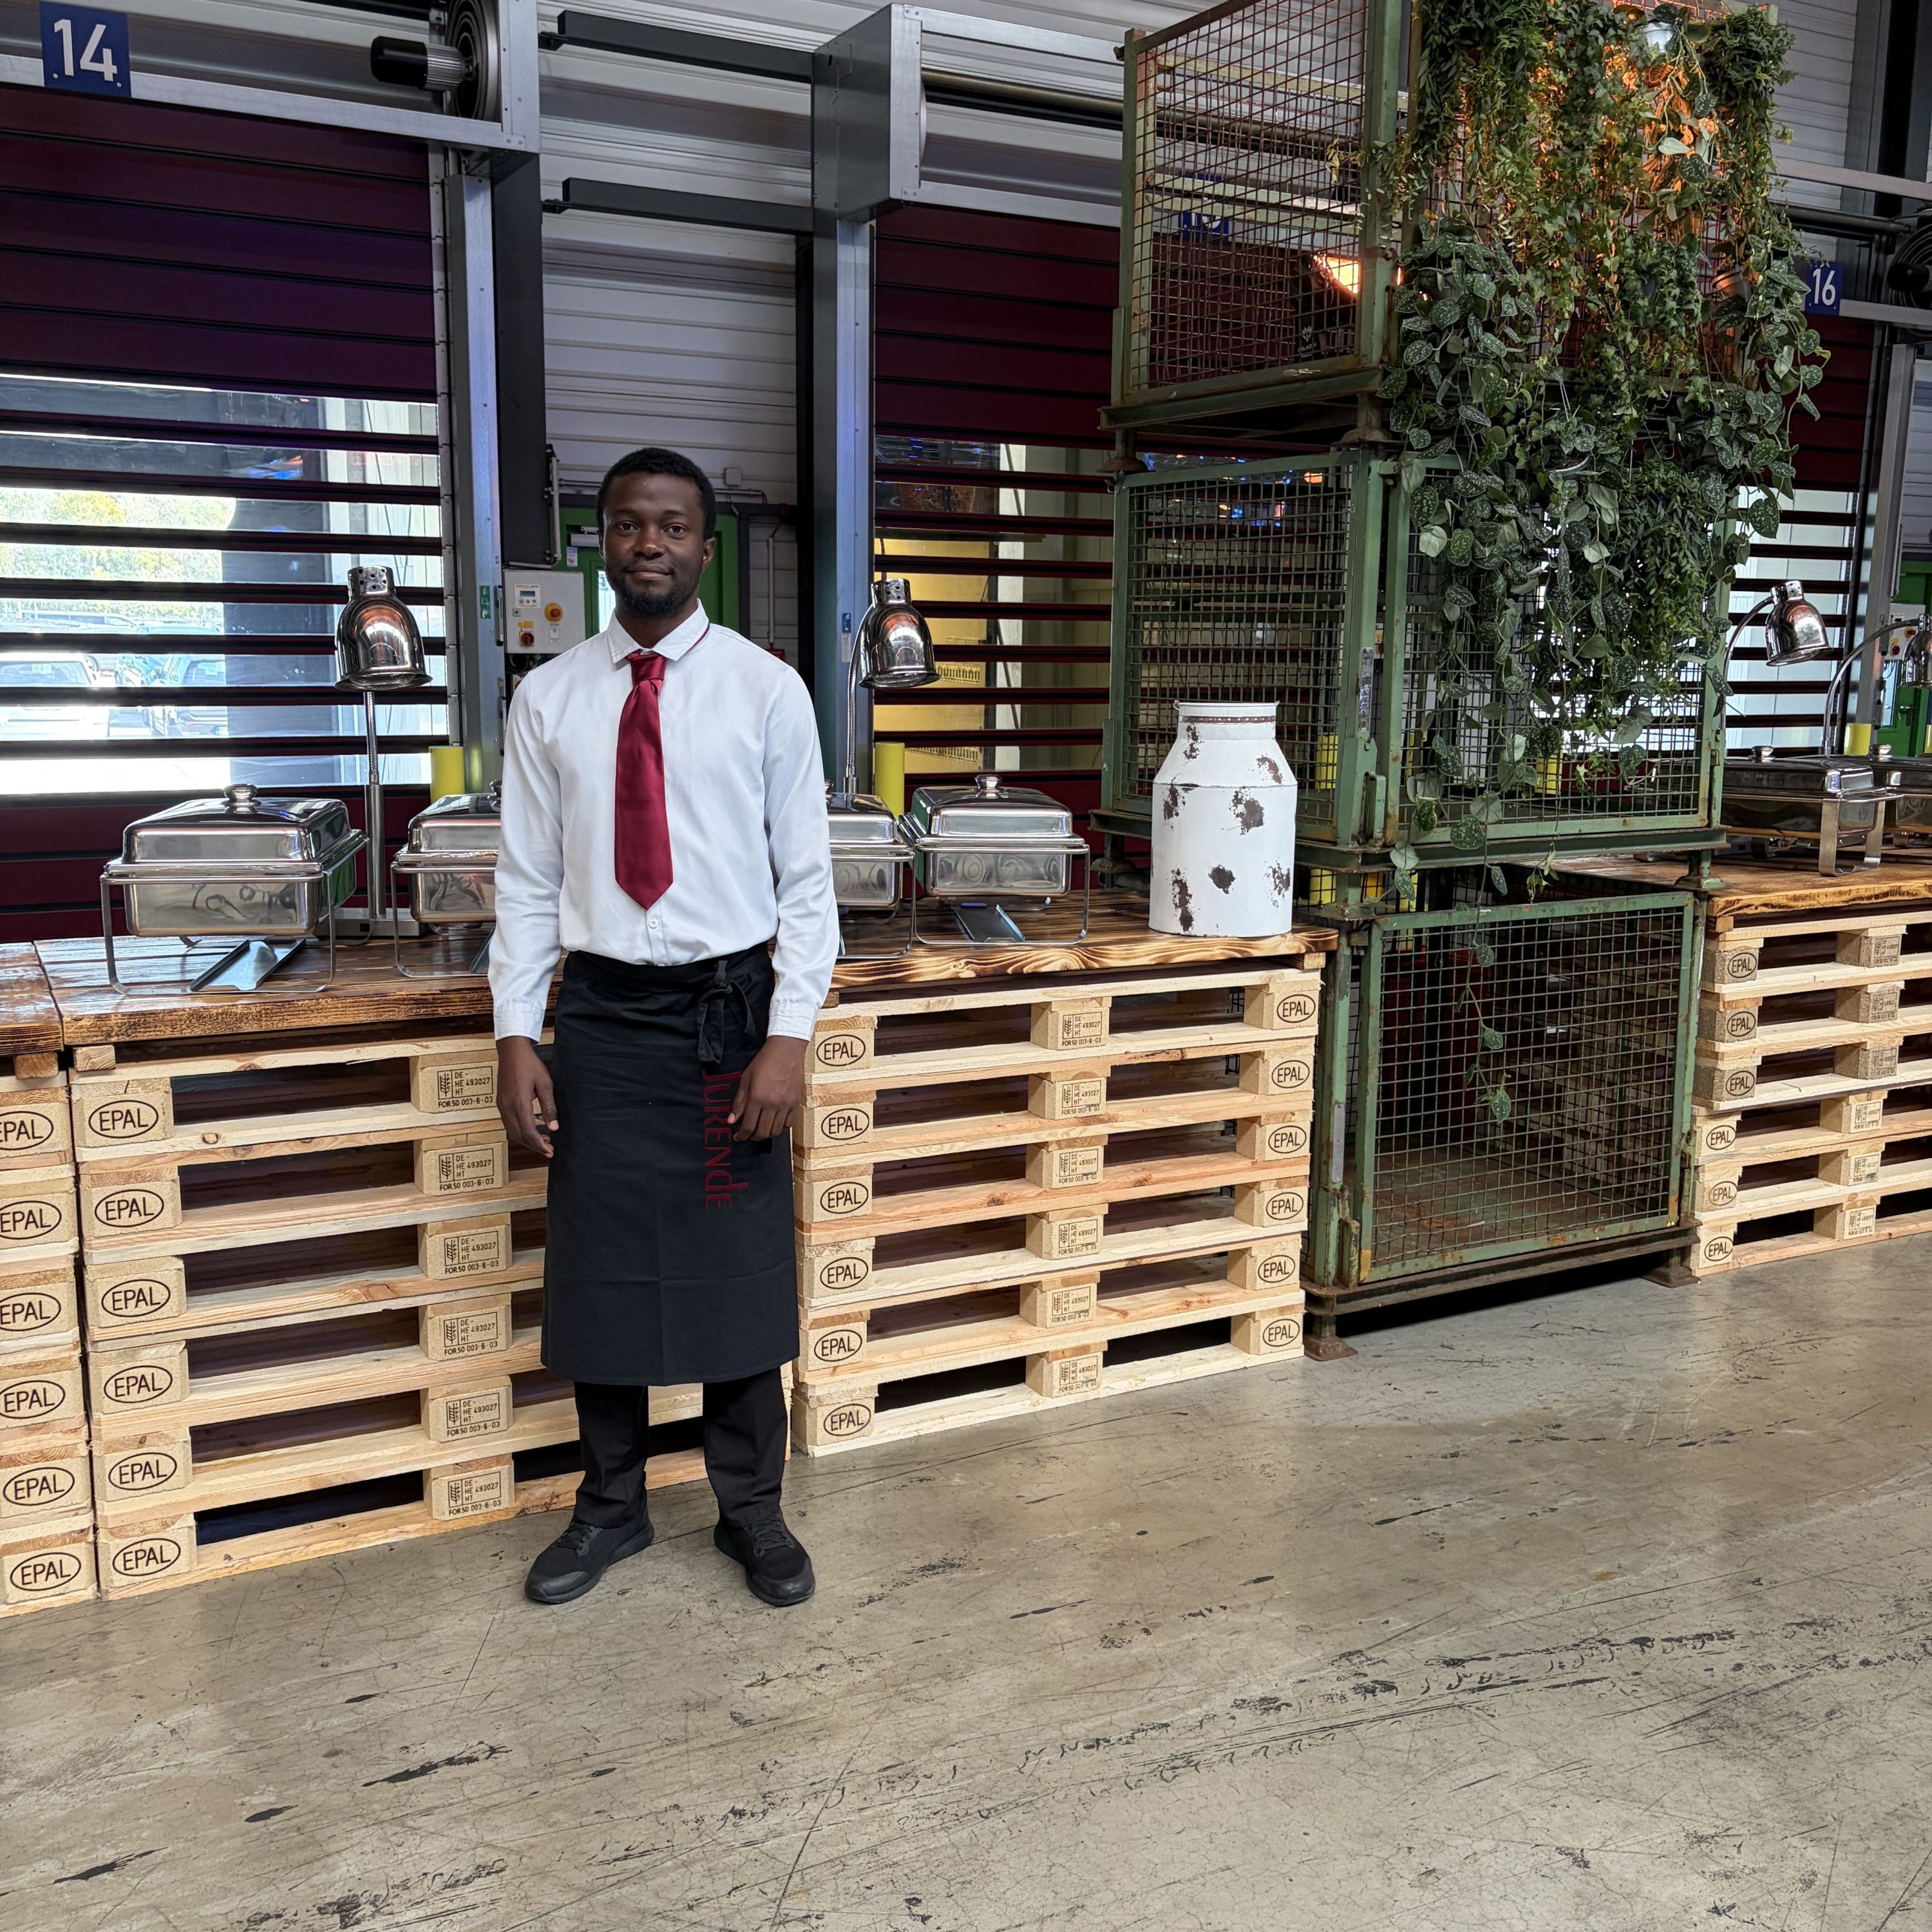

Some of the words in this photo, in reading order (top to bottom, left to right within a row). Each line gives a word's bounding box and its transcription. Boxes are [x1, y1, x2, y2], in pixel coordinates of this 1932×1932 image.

[54, 19, 117, 82] 14
[1813, 268, 1835, 306] 16
[1732, 958, 1752, 973] EPAL
[1282, 1001, 1309, 1017] EPAL
[1730, 1017, 1751, 1032] EPAL
[824, 1041, 858, 1061] EPAL
[466, 1077, 490, 1086] 493027
[1277, 1066, 1304, 1083] EPAL
[1730, 1077, 1750, 1092] EPAL
[99, 1108, 149, 1132] EPAL
[829, 1115, 863, 1134] EPAL
[0, 1119, 43, 1142] PAL
[1274, 1132, 1301, 1148] EPAL
[1710, 1130, 1731, 1146] EPAL
[468, 1160, 491, 1169] 493027
[828, 1189, 862, 1208] EPAL
[1713, 1186, 1733, 1202] EPAL
[105, 1198, 155, 1221] EPAL
[1271, 1198, 1298, 1215] EPAL
[0, 1209, 51, 1233] EPAL
[473, 1242, 496, 1251] 493027
[1709, 1242, 1729, 1257] EPAL
[827, 1264, 861, 1284] EPAL
[1264, 1261, 1289, 1278] EPAL
[111, 1289, 161, 1311] EPAL
[0, 1300, 51, 1325] EPAL
[472, 1323, 495, 1332] 493027
[1268, 1324, 1294, 1342] EPAL
[821, 1336, 855, 1356] EPAL
[114, 1373, 163, 1398] EPAL
[4, 1387, 55, 1413] EPAL
[475, 1404, 497, 1413] 493027
[830, 1410, 864, 1432] EPAL
[118, 1459, 167, 1485] EPAL
[14, 1474, 64, 1501] EPAL
[475, 1482, 498, 1492] 493027
[123, 1544, 171, 1571] EPAL
[21, 1558, 71, 1585] EPAL
